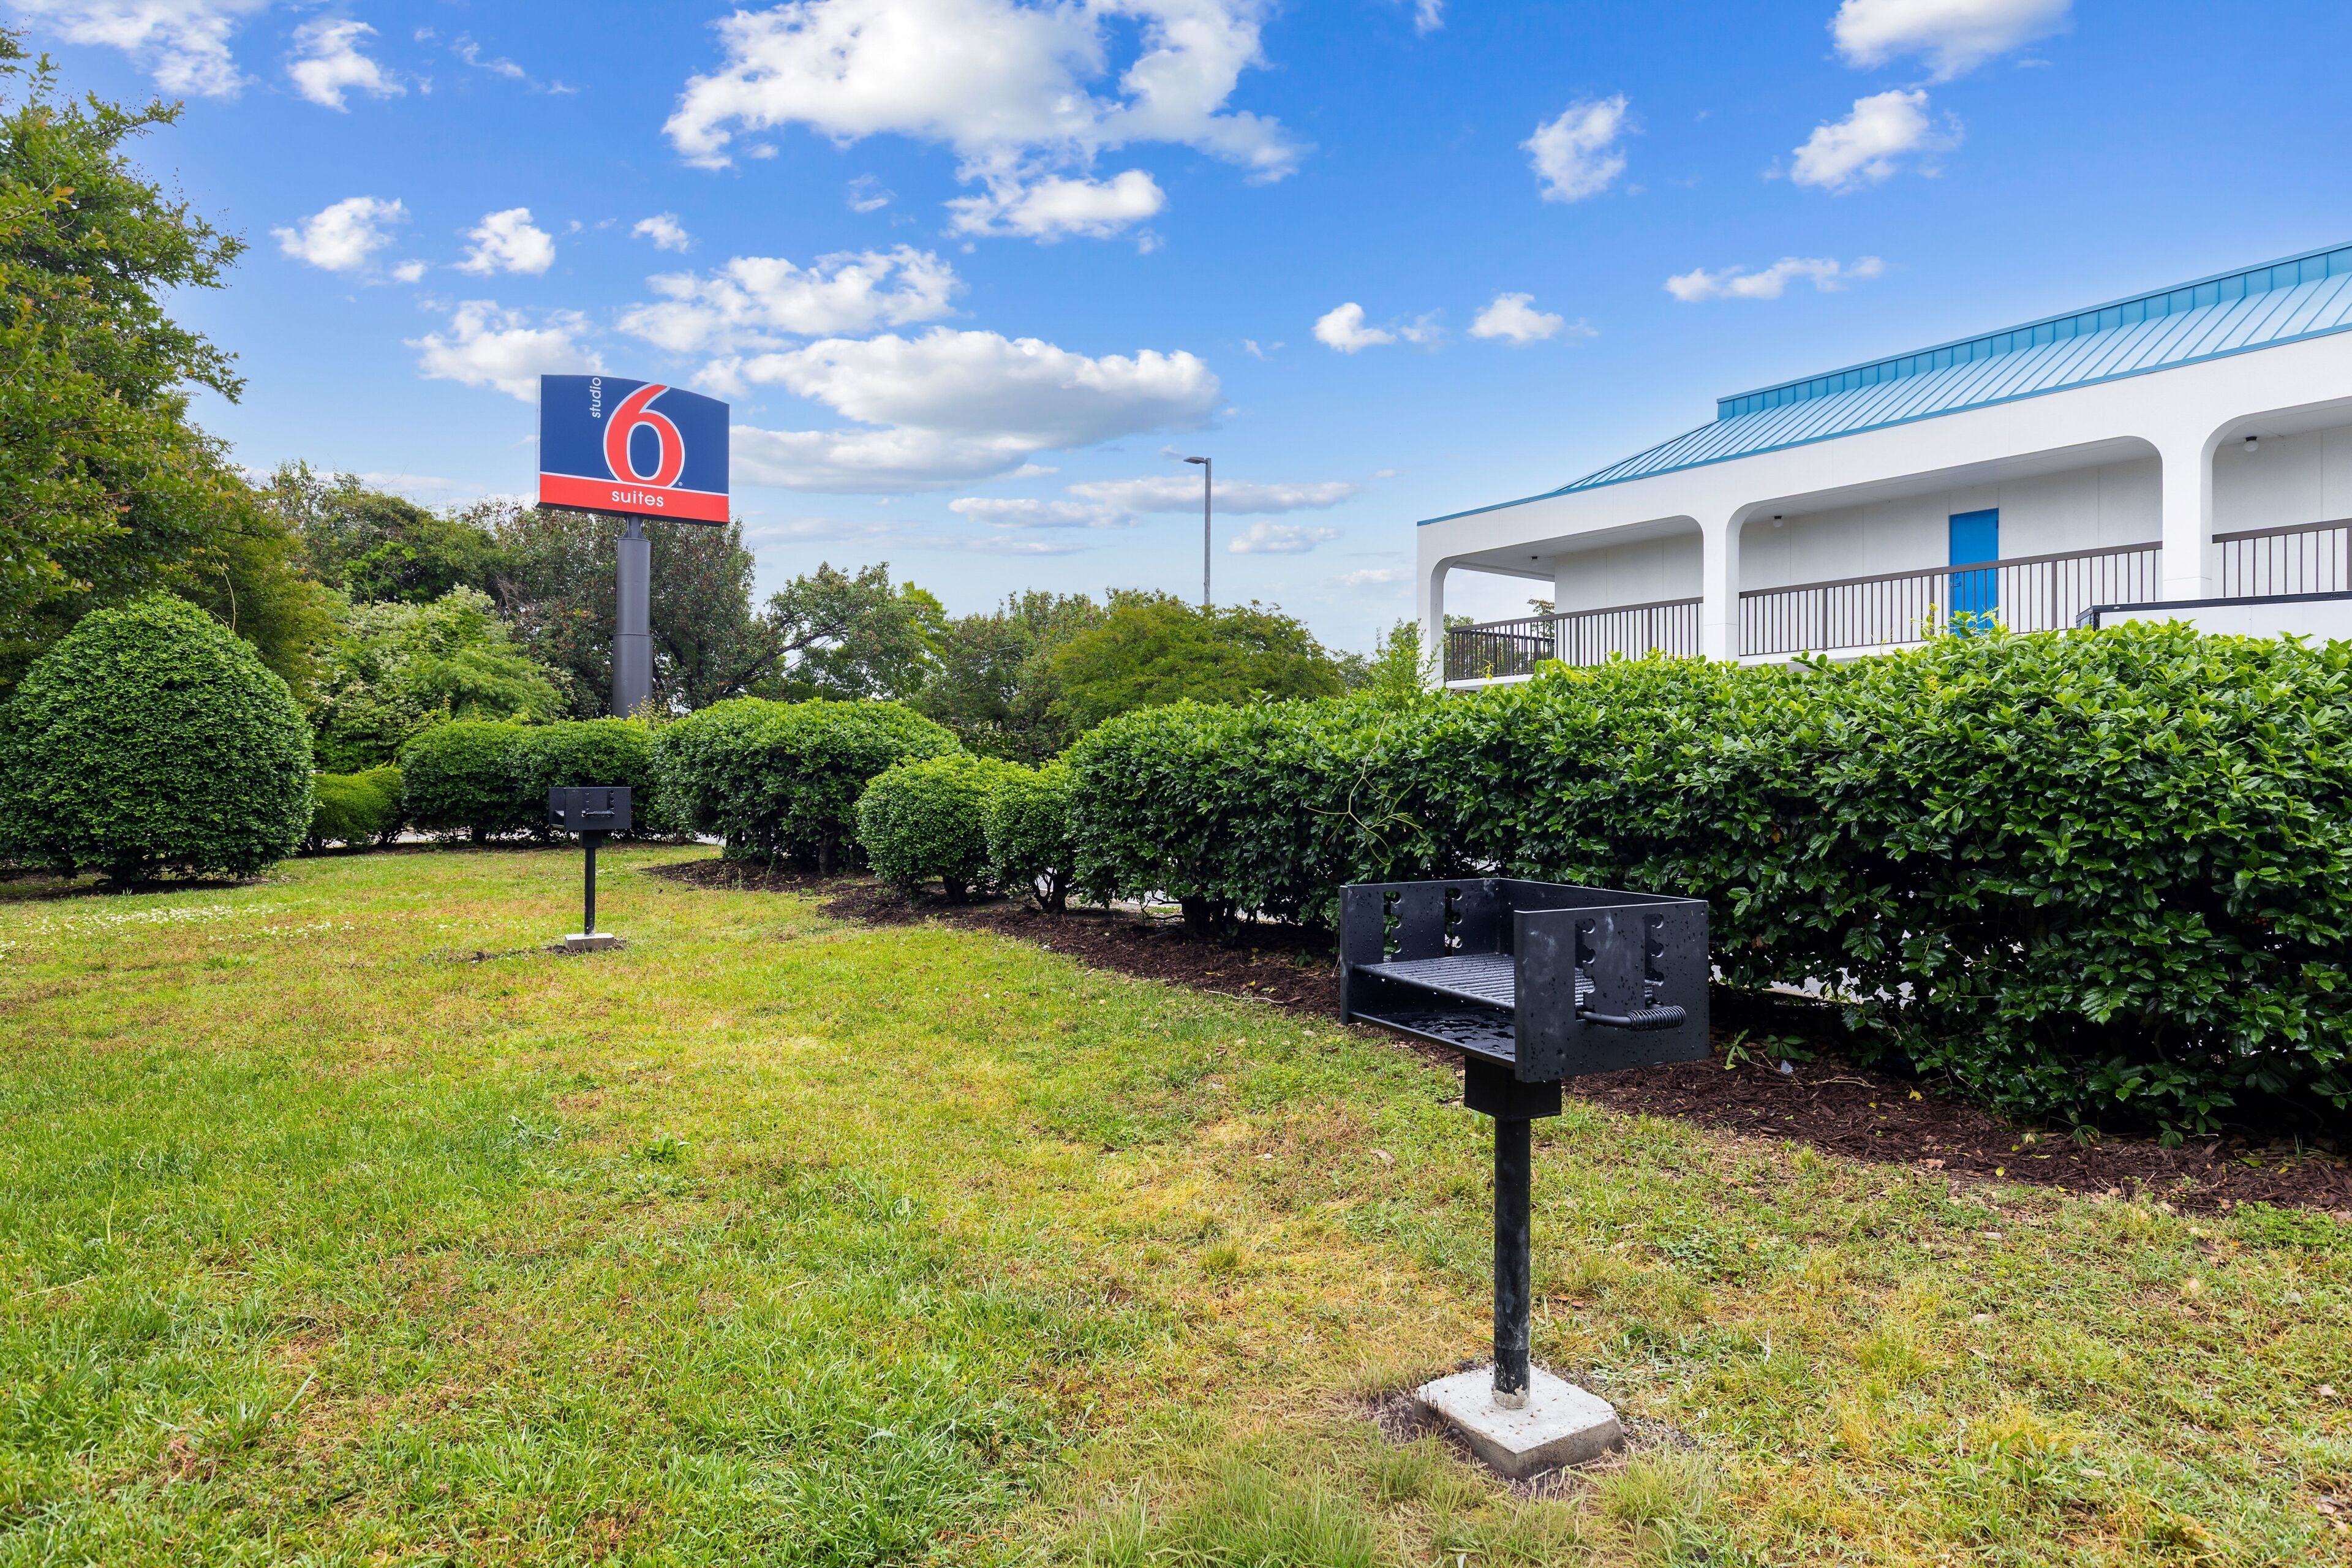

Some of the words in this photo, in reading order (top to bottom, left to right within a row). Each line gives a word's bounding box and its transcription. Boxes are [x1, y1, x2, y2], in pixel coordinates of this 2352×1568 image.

[589, 377, 601, 418] studio
[603, 383, 685, 488] 6
[611, 491, 664, 507] suites
